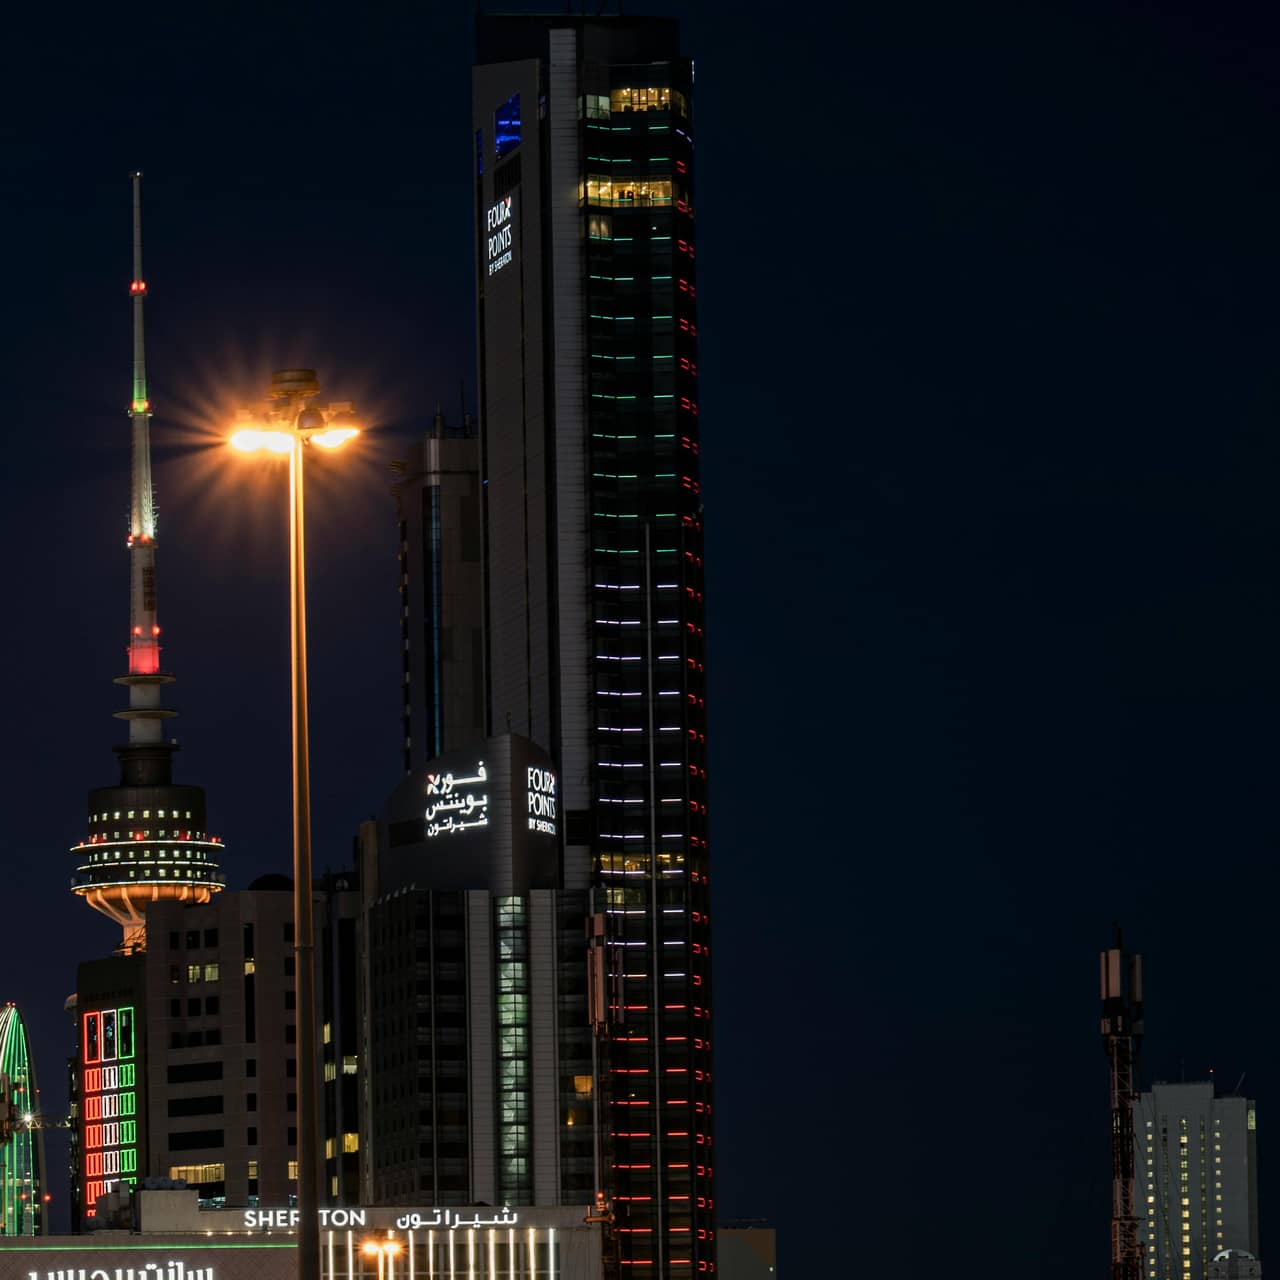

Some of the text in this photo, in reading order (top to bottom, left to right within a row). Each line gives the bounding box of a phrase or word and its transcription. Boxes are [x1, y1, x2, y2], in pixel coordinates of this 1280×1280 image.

[488, 223, 512, 260] POINTS
[527, 791, 556, 820] POINTS
[244, 1209, 366, 1228] SHERTON
[396, 1206, 518, 1230] شيراتون
